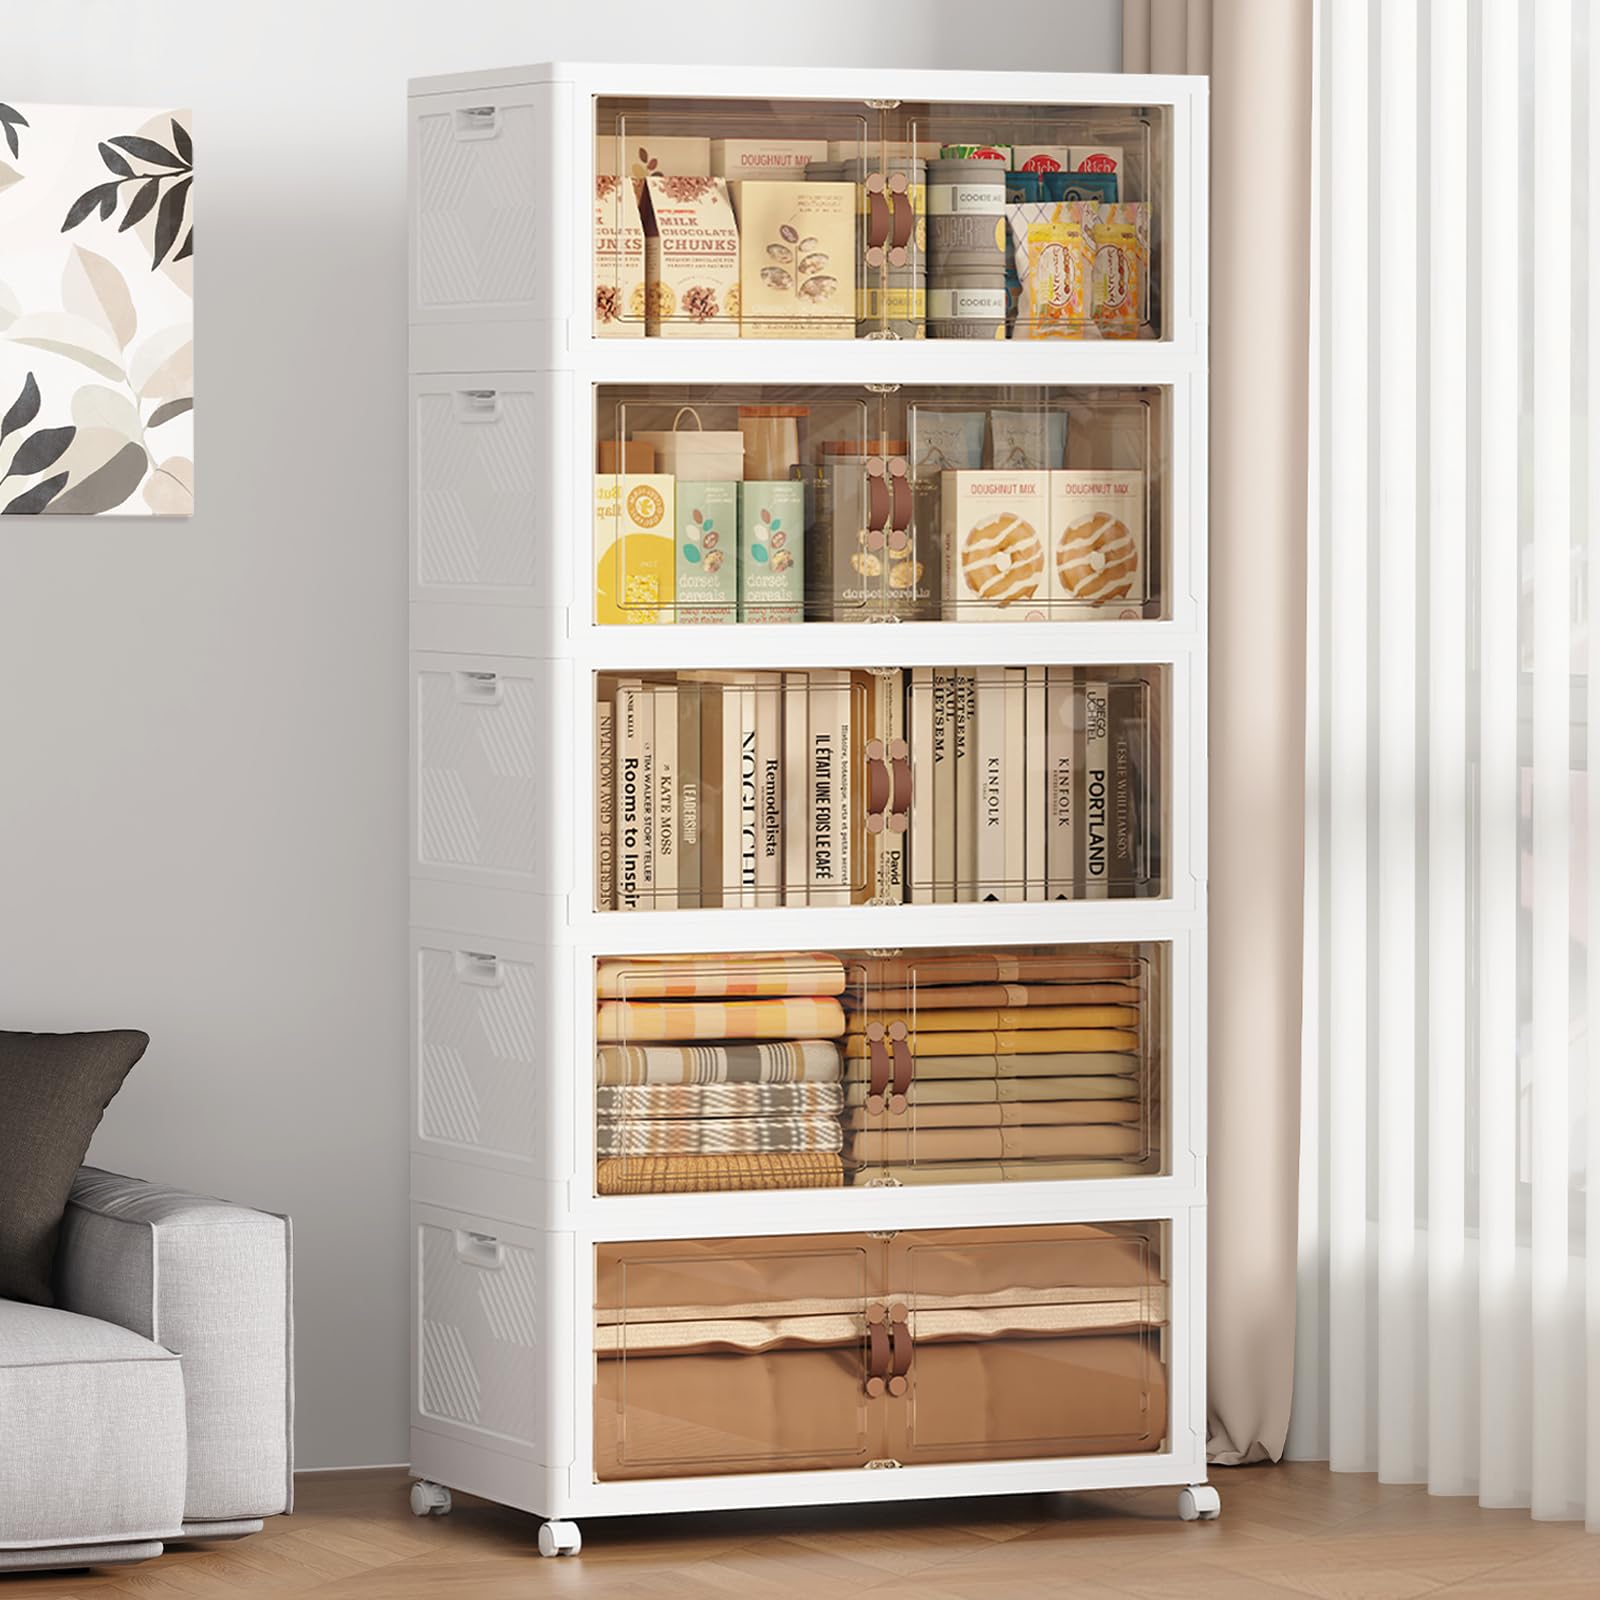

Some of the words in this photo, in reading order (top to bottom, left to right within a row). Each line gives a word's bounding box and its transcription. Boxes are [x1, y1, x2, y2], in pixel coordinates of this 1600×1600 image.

[741, 154, 792, 166] DOUGHNUT
[959, 193, 992, 202] COOKIE
[658, 217, 699, 226] MILK
[661, 228, 736, 237] CHOCOLATE
[663, 239, 737, 251] CHUNKS
[959, 298, 992, 306] COOKIE
[970, 483, 1018, 495] DOUGHNUT
[1019, 483, 1037, 495] MIX
[1065, 483, 1112, 495] DOUGHNUT
[1113, 483, 1129, 495] MIX
[680, 574, 721, 588] dorset
[680, 589, 726, 601] cereals
[747, 574, 789, 588] dorset
[747, 589, 793, 601] cereals
[946, 676, 955, 721] PAUL
[967, 676, 975, 720] PAUL
[935, 676, 945, 763] SIETSEMA
[957, 676, 966, 759] SIETSEMA
[1095, 698, 1106, 738] DIEGO
[600, 716, 613, 788] MOUNTAIN
[815, 734, 831, 745] IL
[644, 754, 652, 771] TIM
[815, 747, 834, 779] ÉTAIT
[1116, 741, 1128, 777] LESLIE
[624, 758, 639, 822] Rooms
[643, 774, 652, 814] WALKER
[661, 776, 672, 813] KATE
[815, 781, 831, 804] UNE
[987, 757, 1000, 827] KINFOLK
[1058, 757, 1070, 827] KINFOLK
[600, 790, 613, 825] GRAY
[683, 783, 697, 845] LEADERSHIP
[765, 759, 780, 857] Remodelista
[815, 807, 831, 832] FOIS
[1088, 770, 1105, 876] PORTLAND
[624, 827, 639, 848] to
[643, 816, 652, 848] STORY
[660, 816, 672, 855] MOSS
[815, 834, 831, 848] LE
[600, 850, 612, 905] SECRETO
[643, 850, 652, 882] TELLER
[815, 850, 834, 879] CAFÉ
[890, 850, 900, 886] David
[620, 854, 640, 911] Inspir
